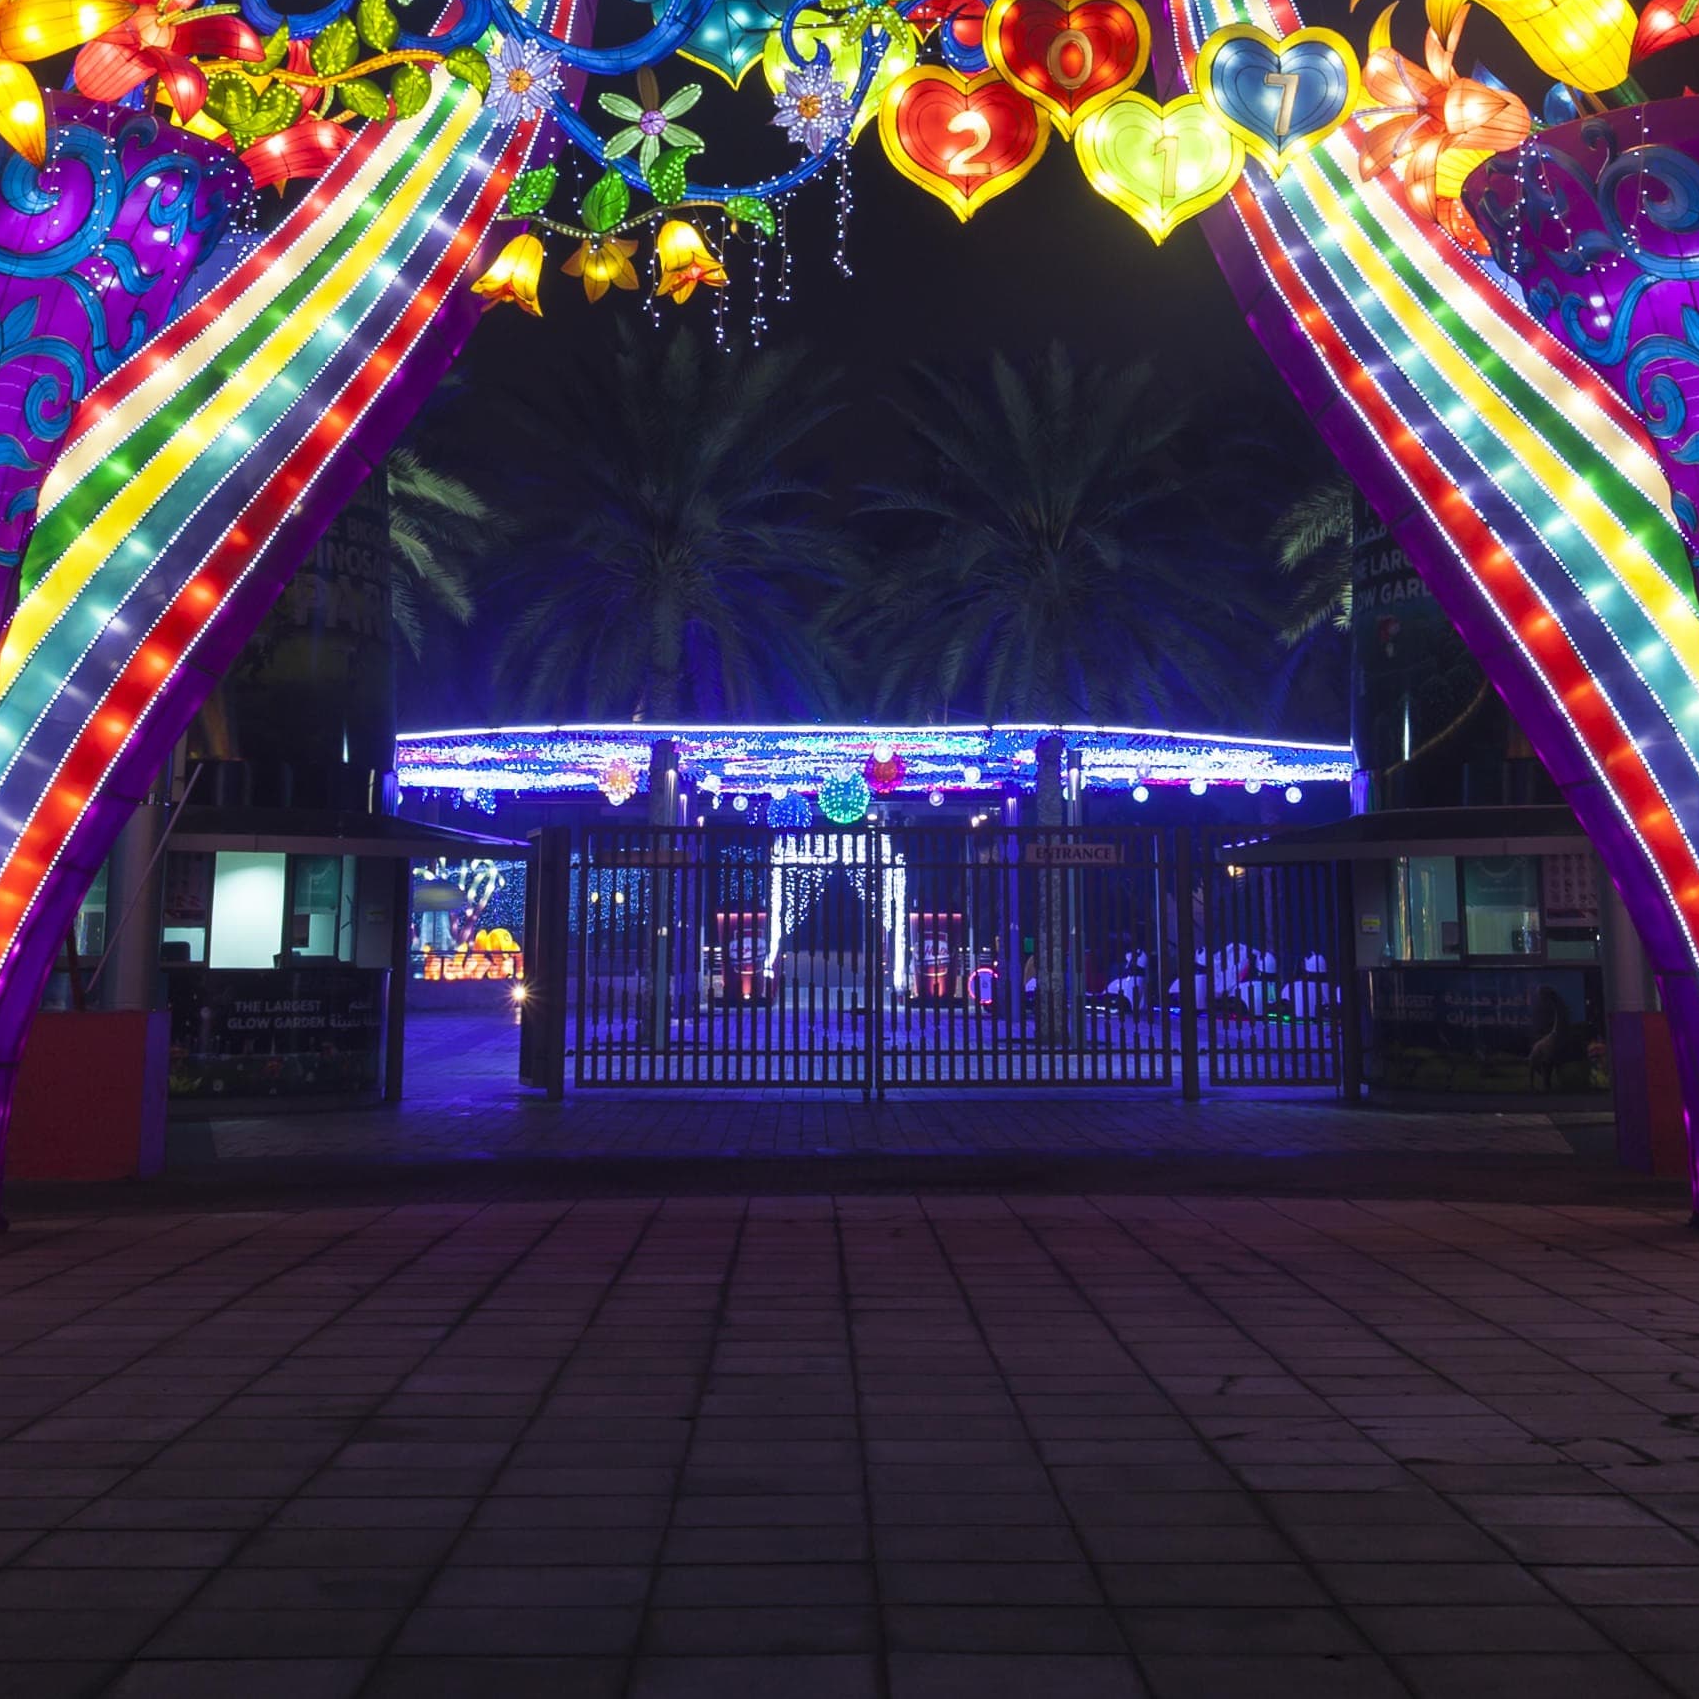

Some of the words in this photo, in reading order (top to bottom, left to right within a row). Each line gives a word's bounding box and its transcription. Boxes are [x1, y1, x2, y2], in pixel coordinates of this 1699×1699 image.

[946, 109, 992, 177] 2
[1151, 135, 1179, 198] 1
[1263, 72, 1300, 137] 7
[234, 1000, 262, 1013] THE
[264, 999, 322, 1013] LARGEST
[227, 1016, 271, 1030] GLOW
[274, 1015, 326, 1029] GARDEN
